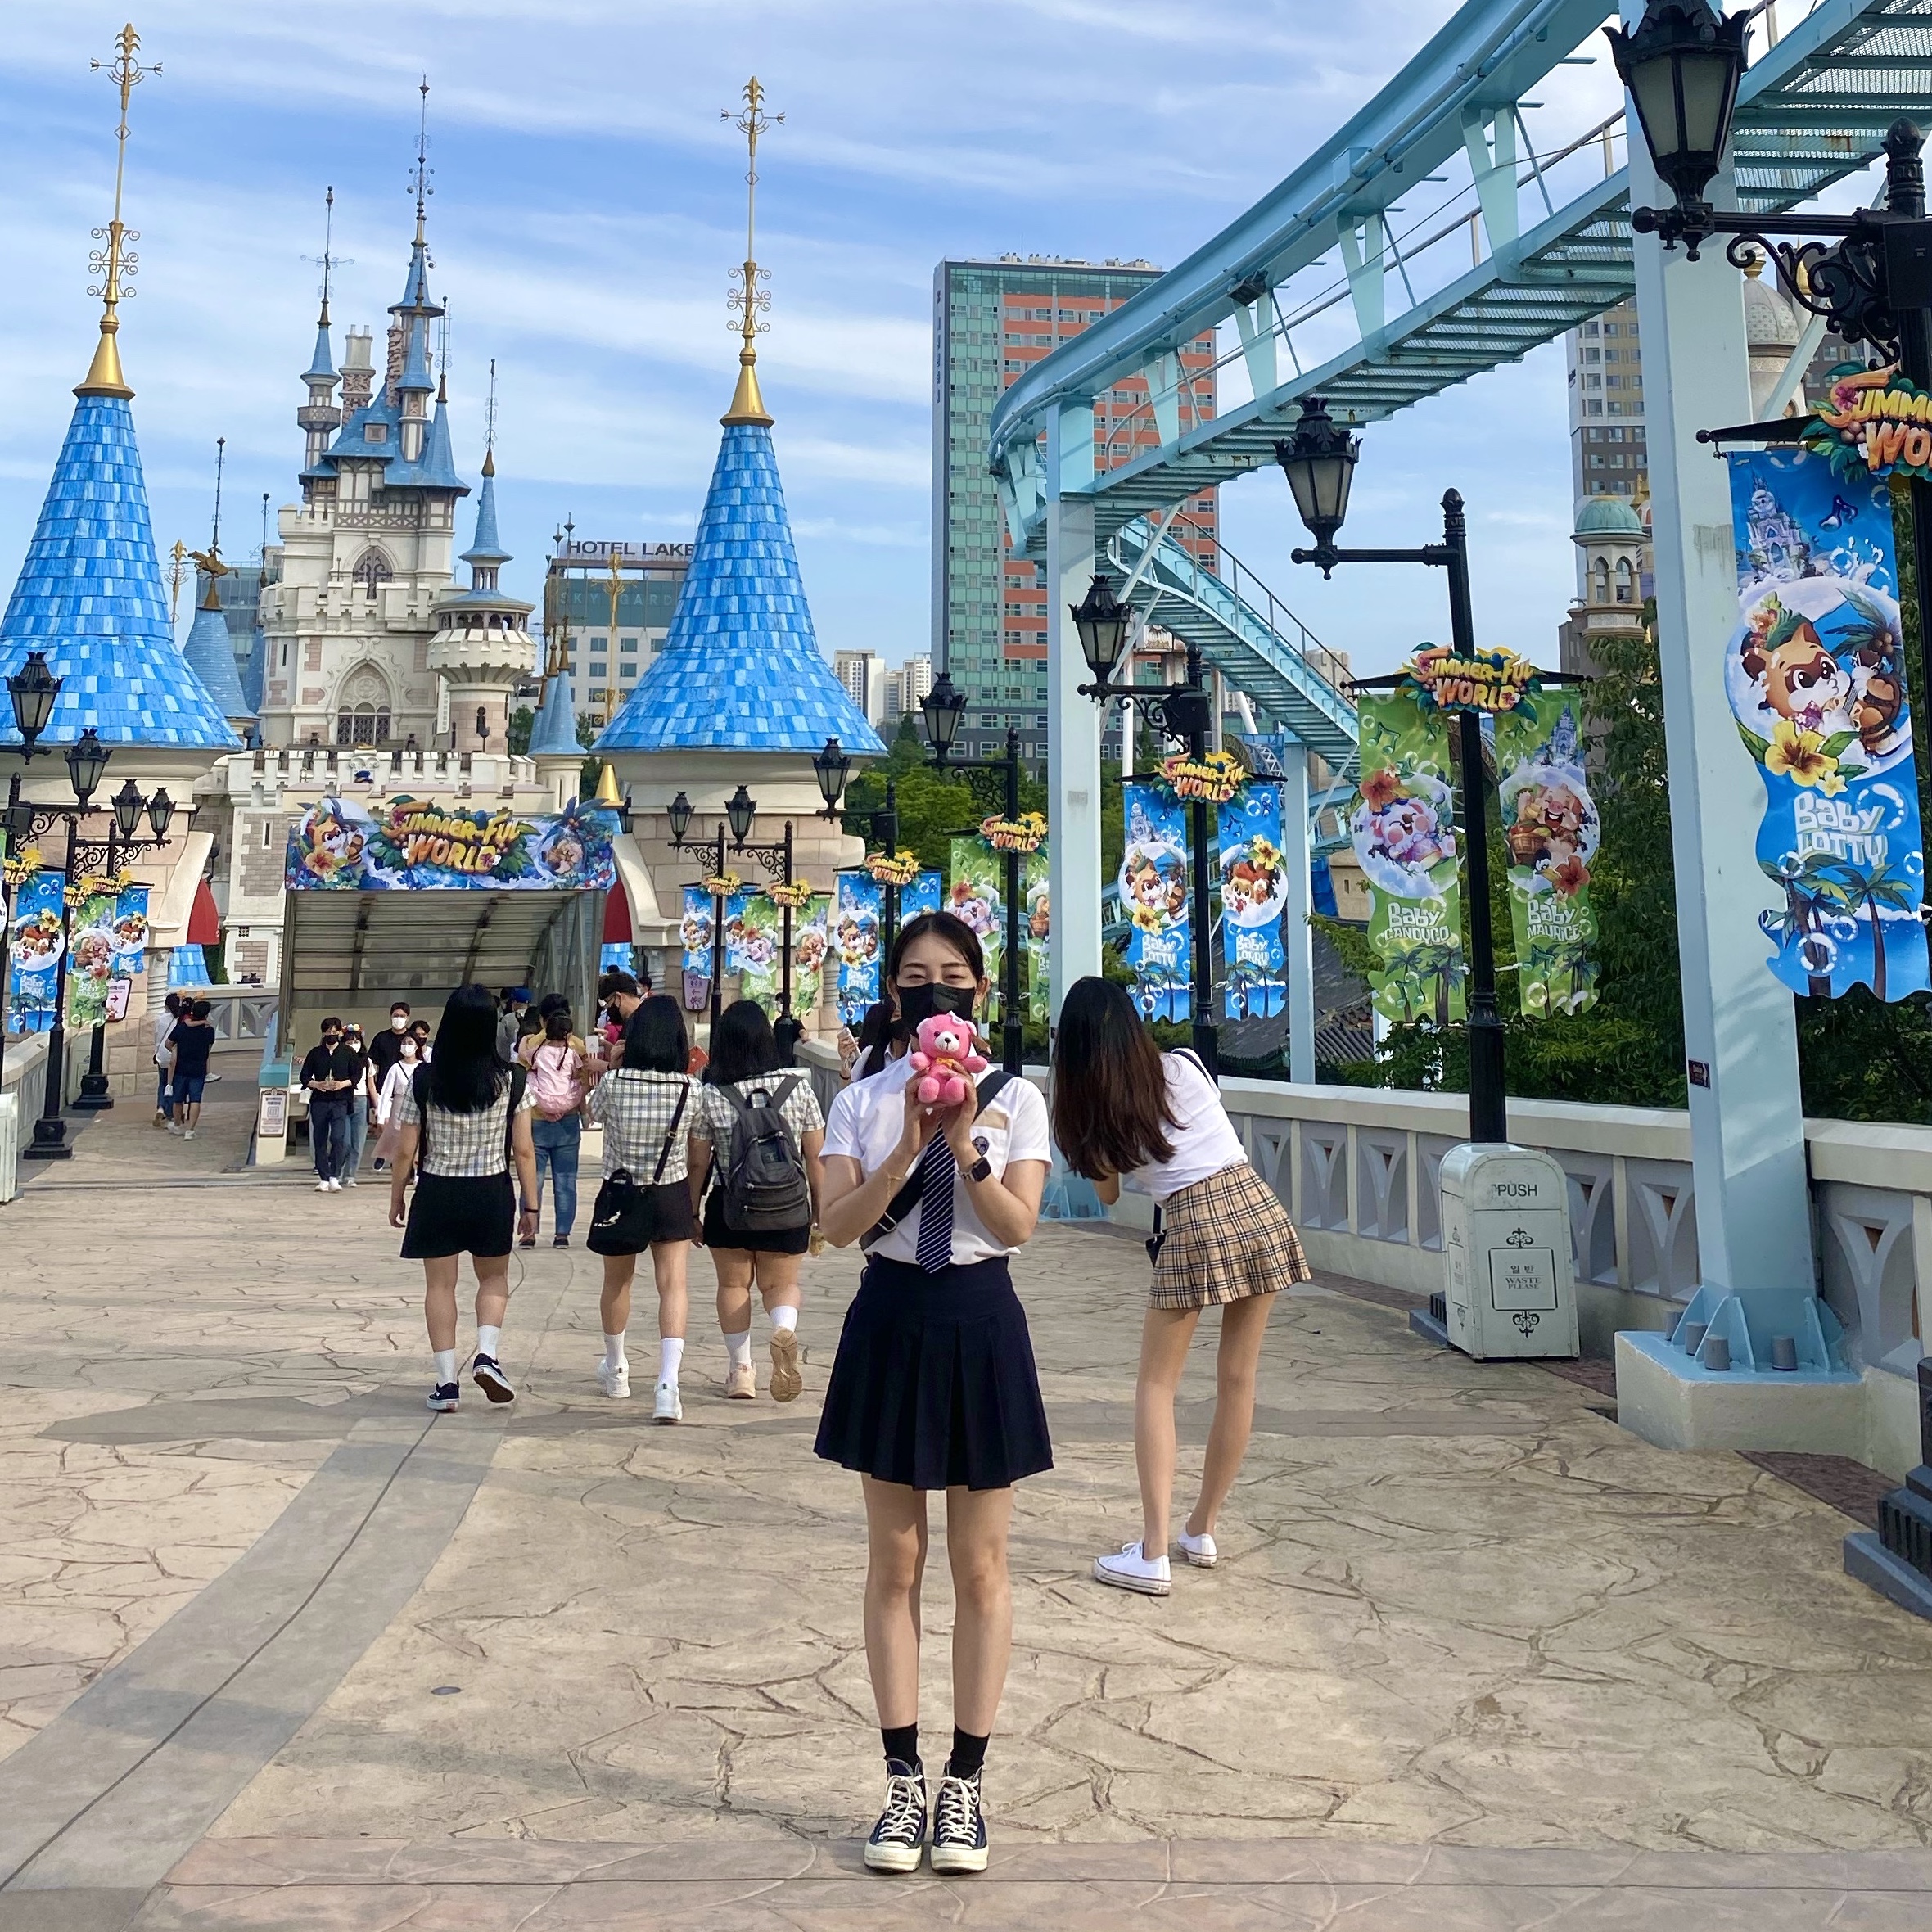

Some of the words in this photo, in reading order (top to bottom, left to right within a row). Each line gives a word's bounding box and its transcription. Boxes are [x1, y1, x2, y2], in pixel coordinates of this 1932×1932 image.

[1817, 359, 1932, 429] SUMM
[1865, 421, 1932, 472] WO
[568, 540, 635, 556] HOTEL
[643, 542, 695, 557] LAKE
[561, 592, 599, 605] SKY
[620, 594, 672, 606] GARD
[1410, 643, 1534, 684] SUMMER-FUL
[1436, 677, 1516, 711] WORLD
[1176, 776, 1231, 802] WORLD
[381, 798, 521, 846] SUMMER-FUL
[1794, 791, 1885, 834] Baby
[407, 833, 497, 873] WORLD
[1388, 902, 1441, 928] Baby
[1528, 899, 1577, 925] Baby
[1142, 934, 1176, 951] Baby
[1236, 934, 1269, 951] Baby
[1497, 1184, 1537, 1197] PUSH
